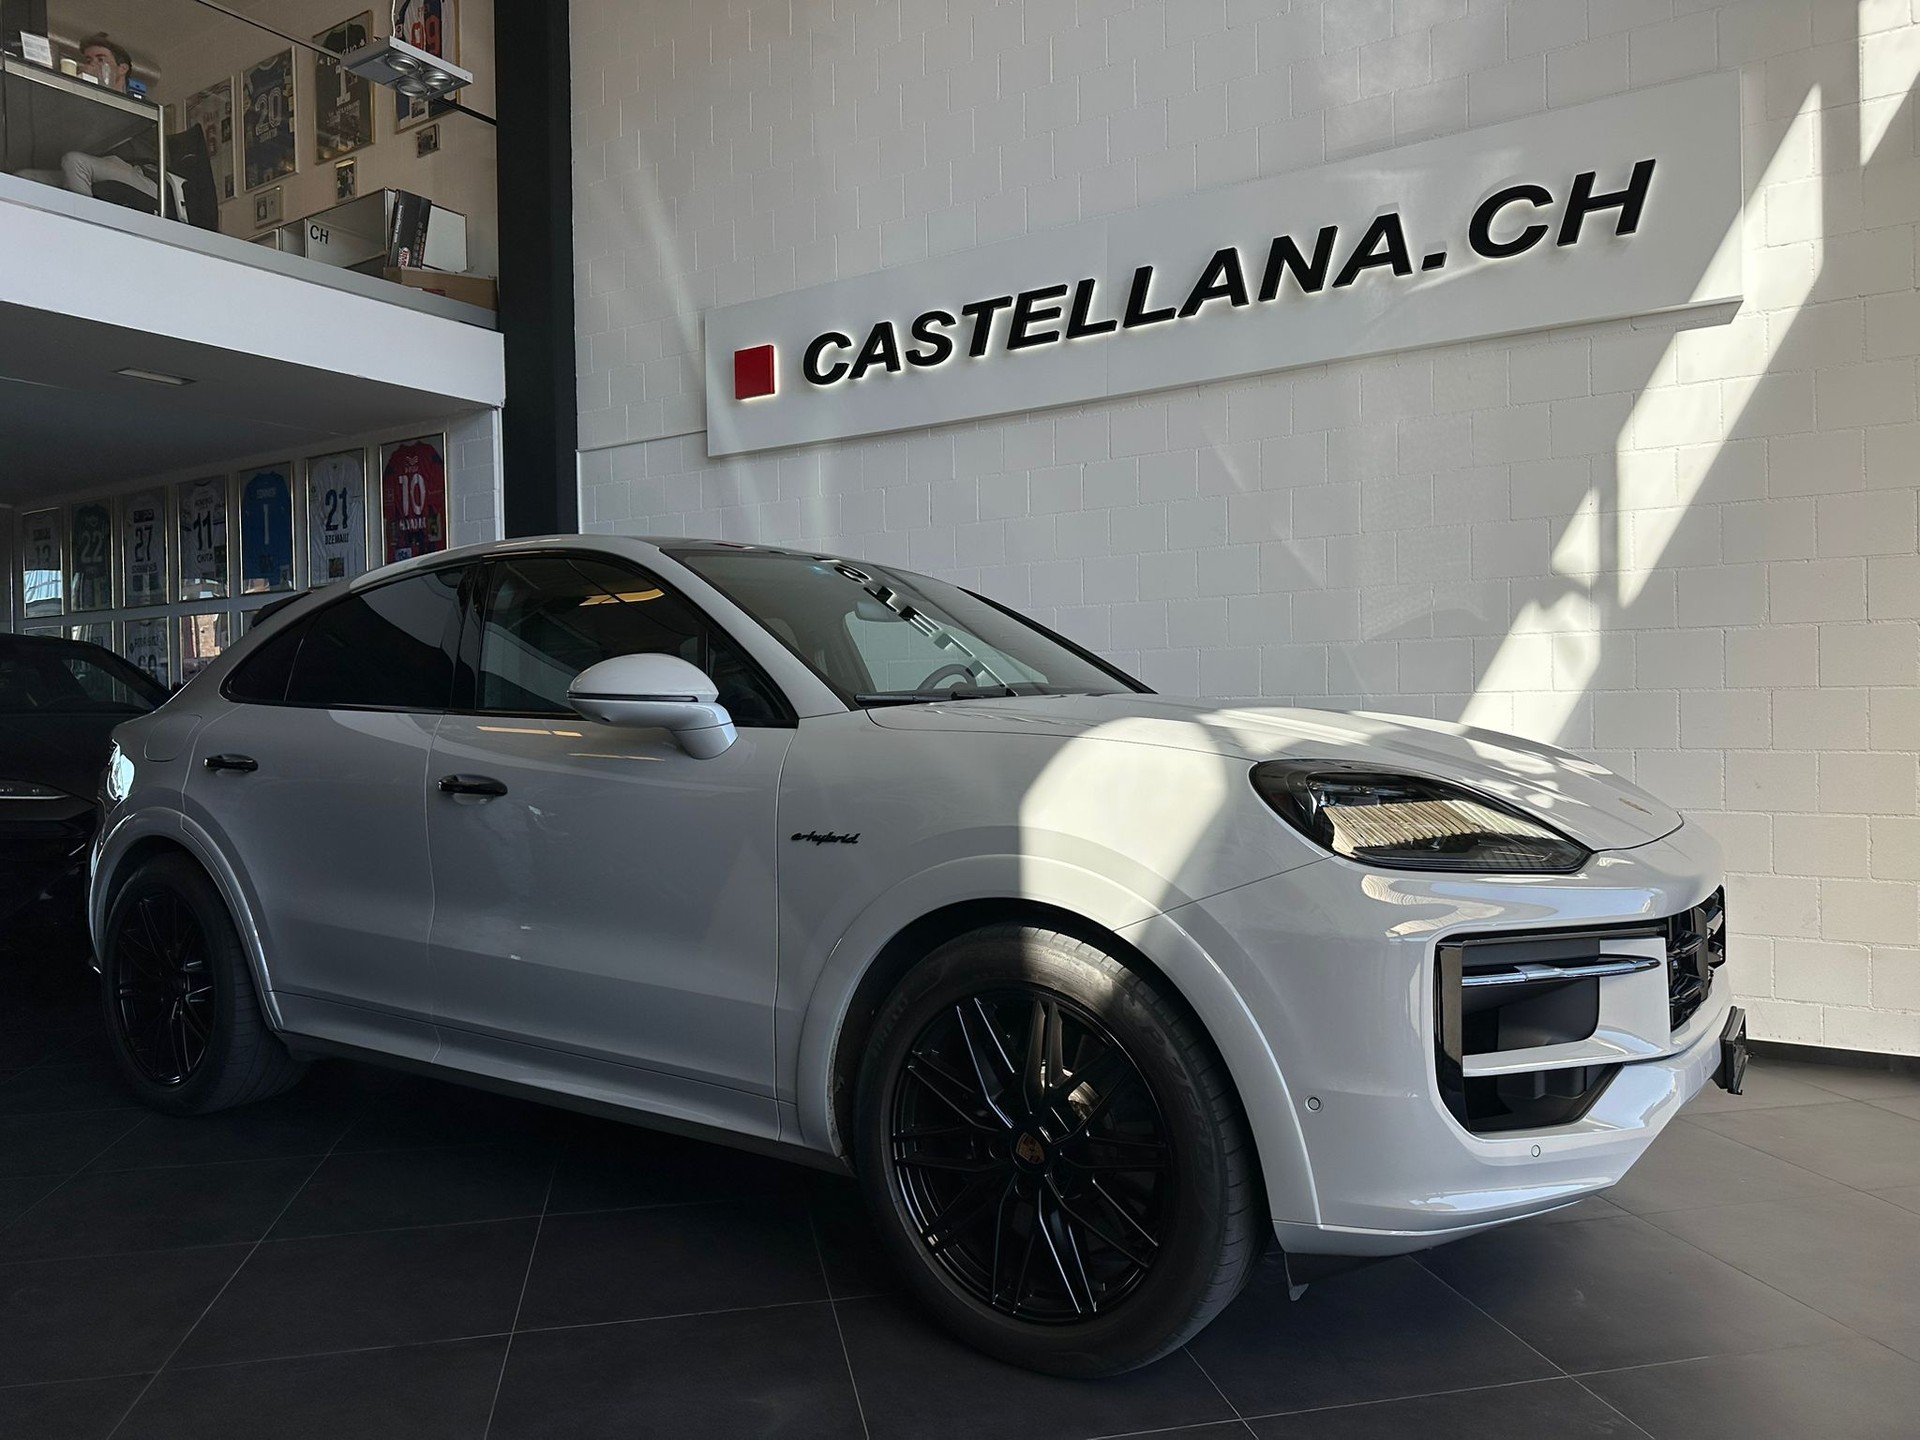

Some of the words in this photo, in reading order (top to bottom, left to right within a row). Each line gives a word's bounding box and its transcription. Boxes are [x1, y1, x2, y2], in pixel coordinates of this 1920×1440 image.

[254, 87, 282, 136] 20
[310, 225, 329, 245] CH
[803, 158, 1657, 386] CASTELLANA.CH
[325, 487, 348, 532] 21
[398, 473, 426, 516] 10
[81, 530, 103, 564] 22
[134, 525, 153, 563] 27
[193, 510, 213, 551] 11
